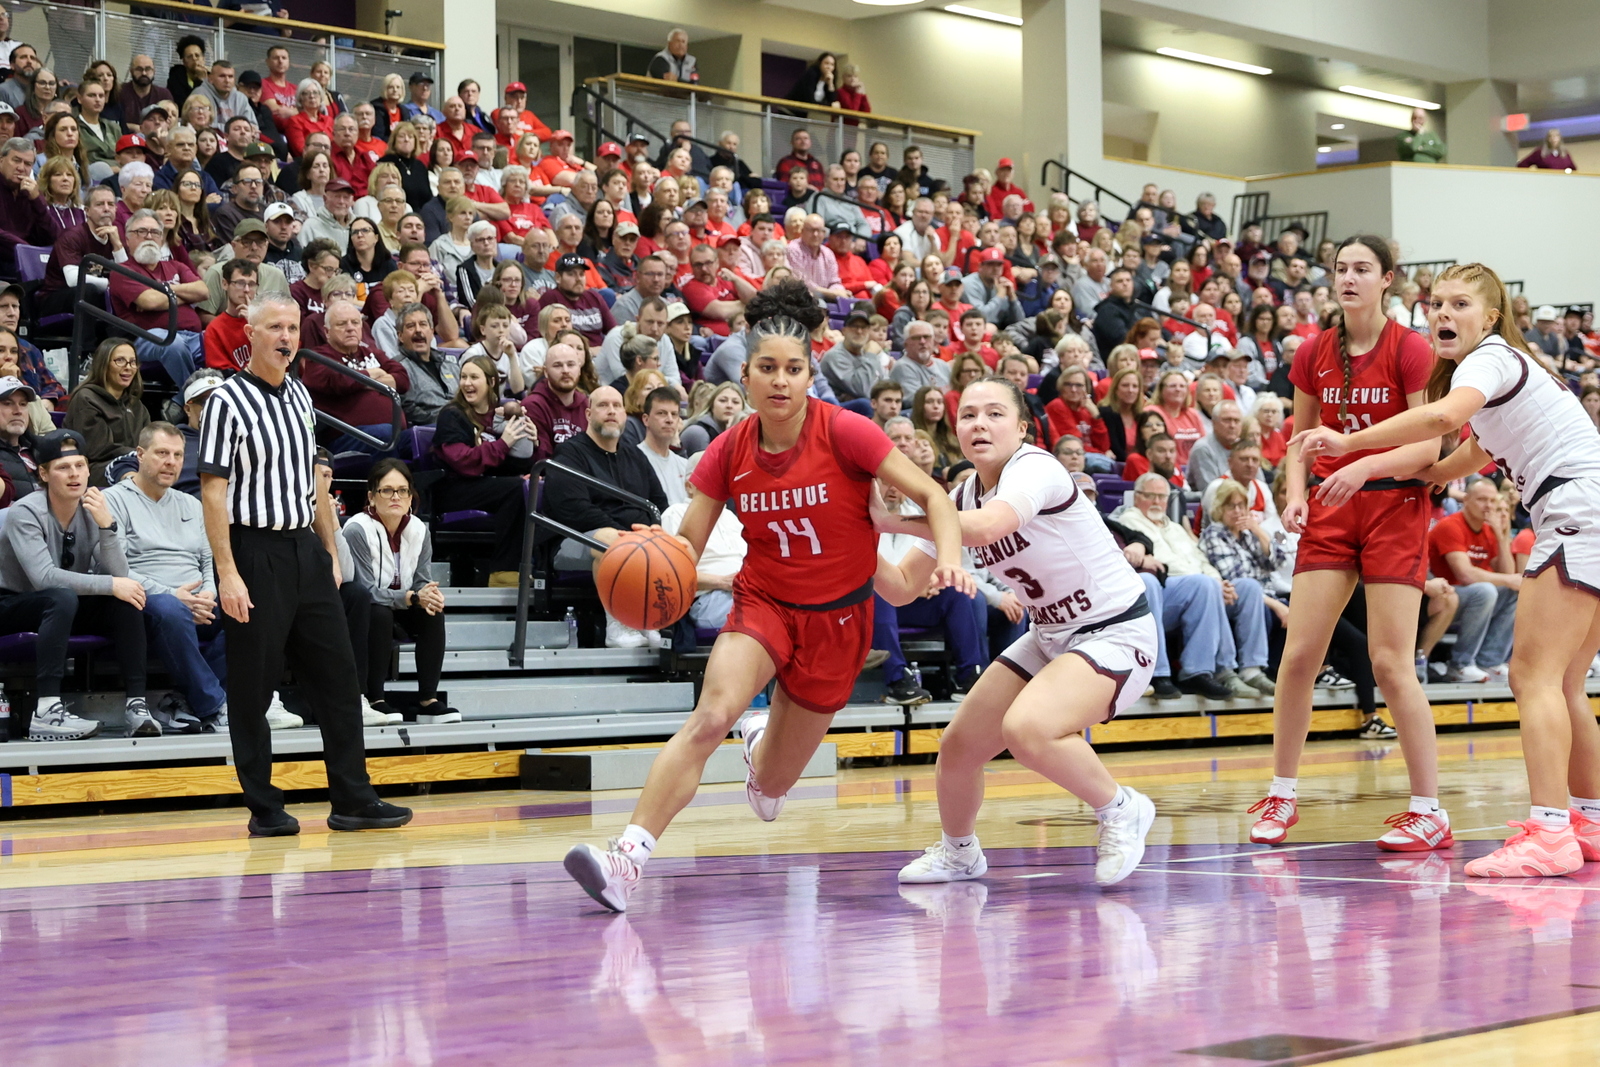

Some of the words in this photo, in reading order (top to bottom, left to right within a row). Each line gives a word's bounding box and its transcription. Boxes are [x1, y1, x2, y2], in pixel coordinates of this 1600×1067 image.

[553, 418, 582, 433] COMTS
[740, 483, 829, 513] BELLEVUE
[767, 517, 822, 558] 14
[1003, 566, 1045, 600] 3
[1027, 588, 1092, 625] METS
